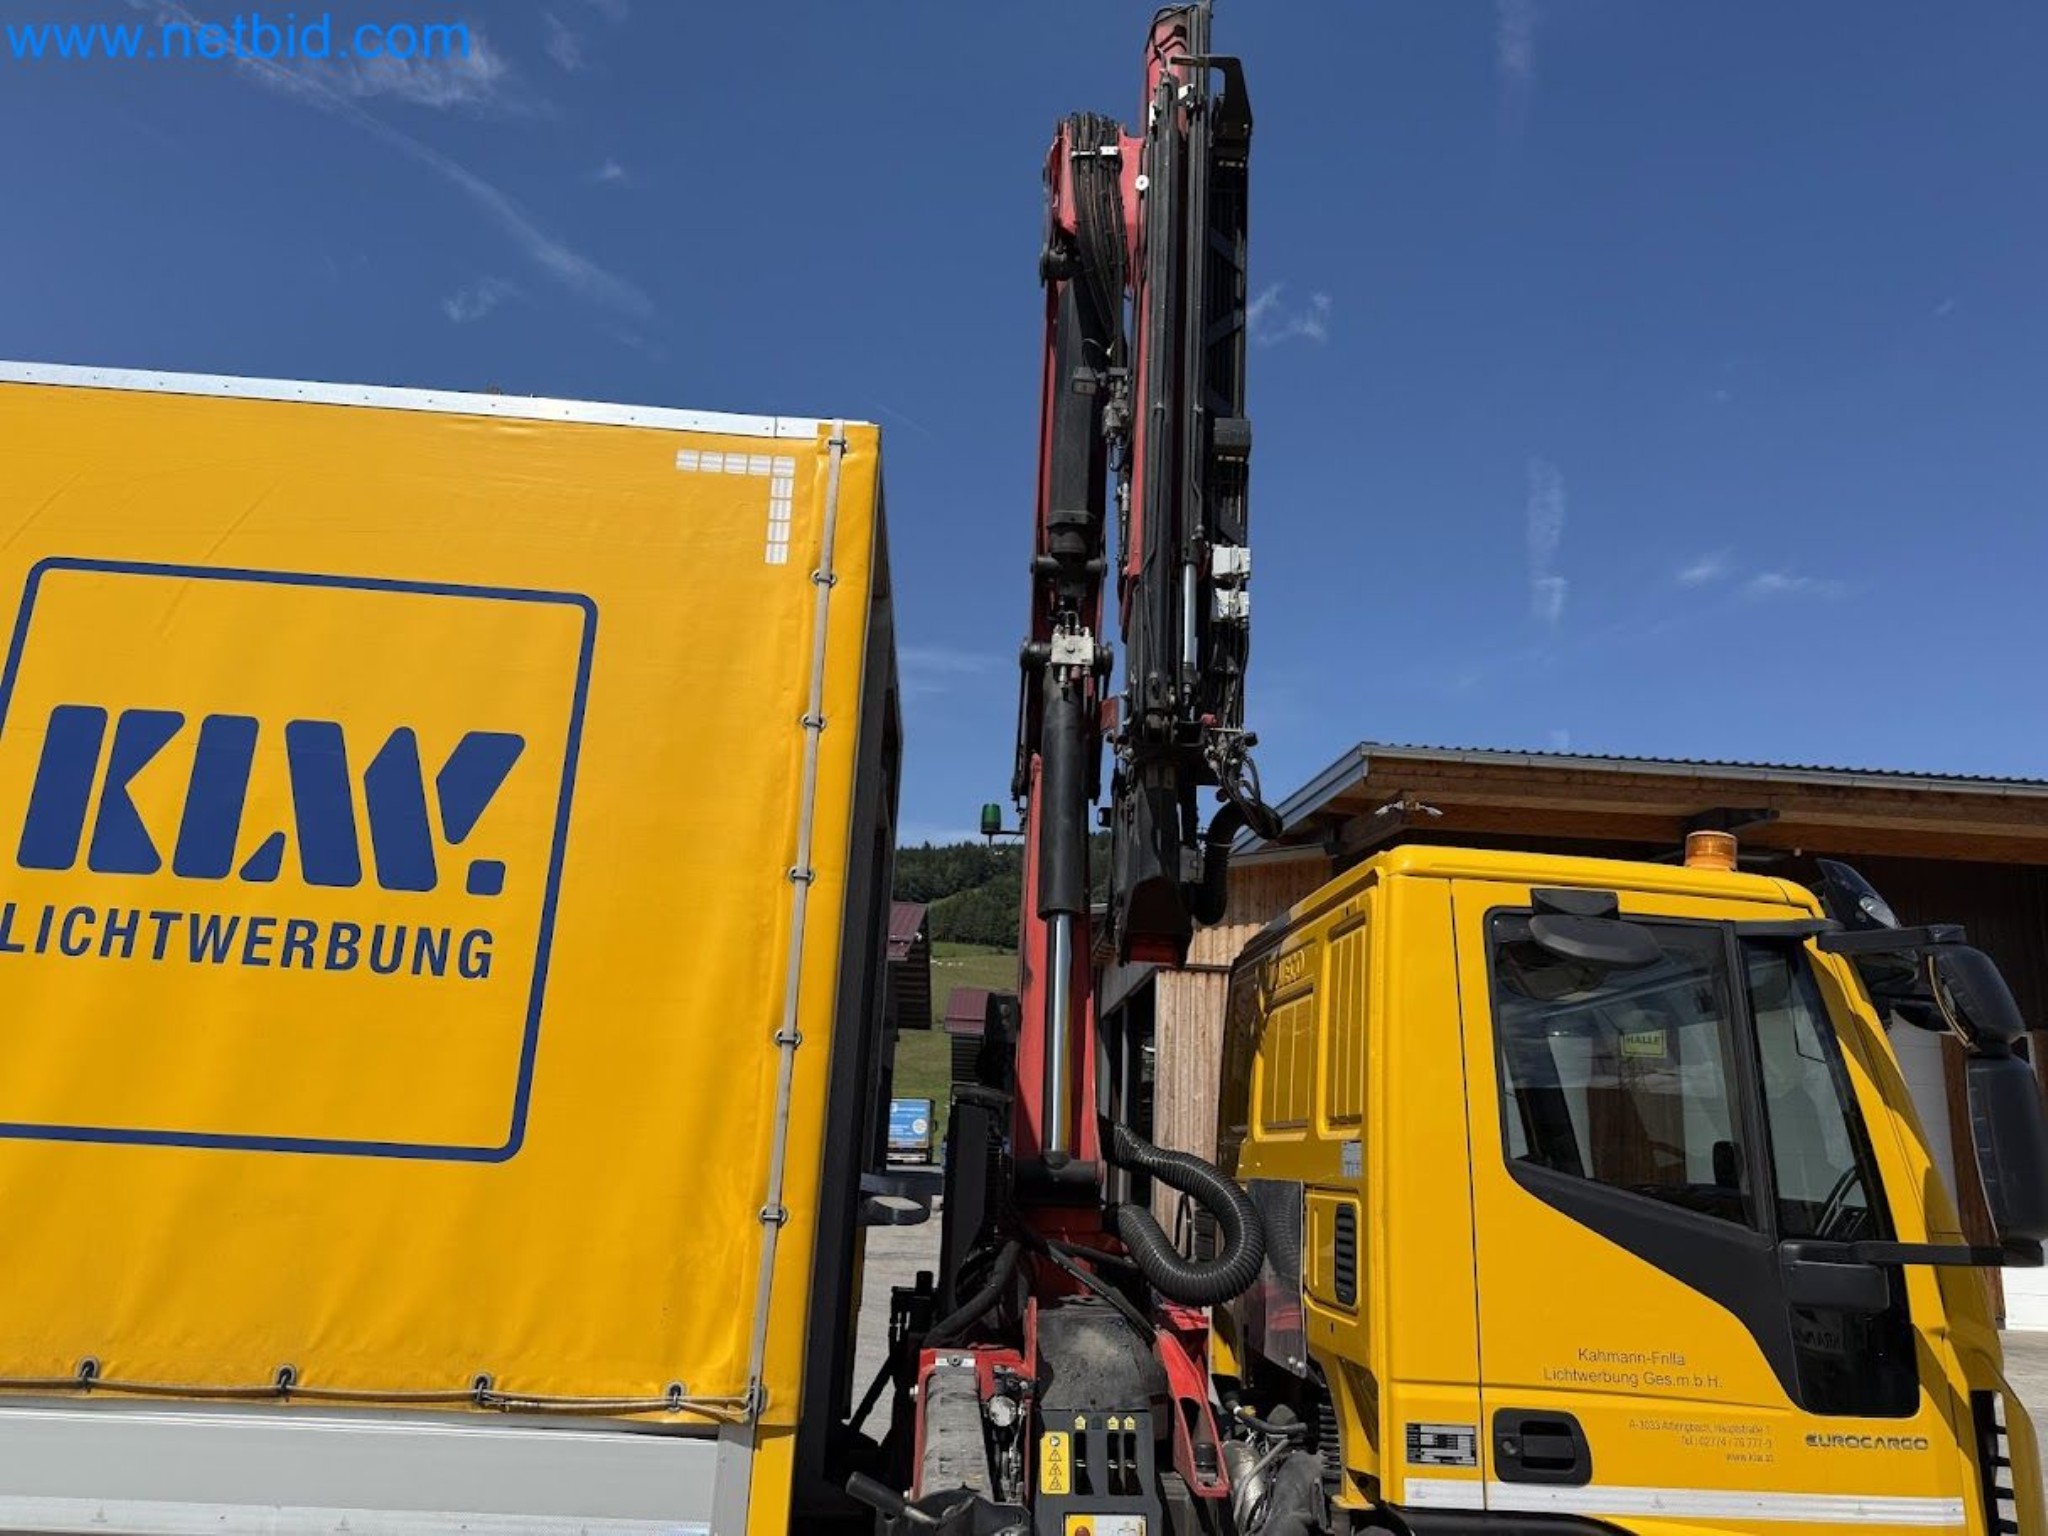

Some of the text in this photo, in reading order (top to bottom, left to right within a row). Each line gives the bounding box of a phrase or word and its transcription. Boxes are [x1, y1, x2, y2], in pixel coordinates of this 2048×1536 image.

[0, 902, 494, 979] LICHTWERBUNG
[1543, 1367, 1639, 1388] Lichtwerbung
[1806, 1433, 1928, 1450] EUROCARGO
